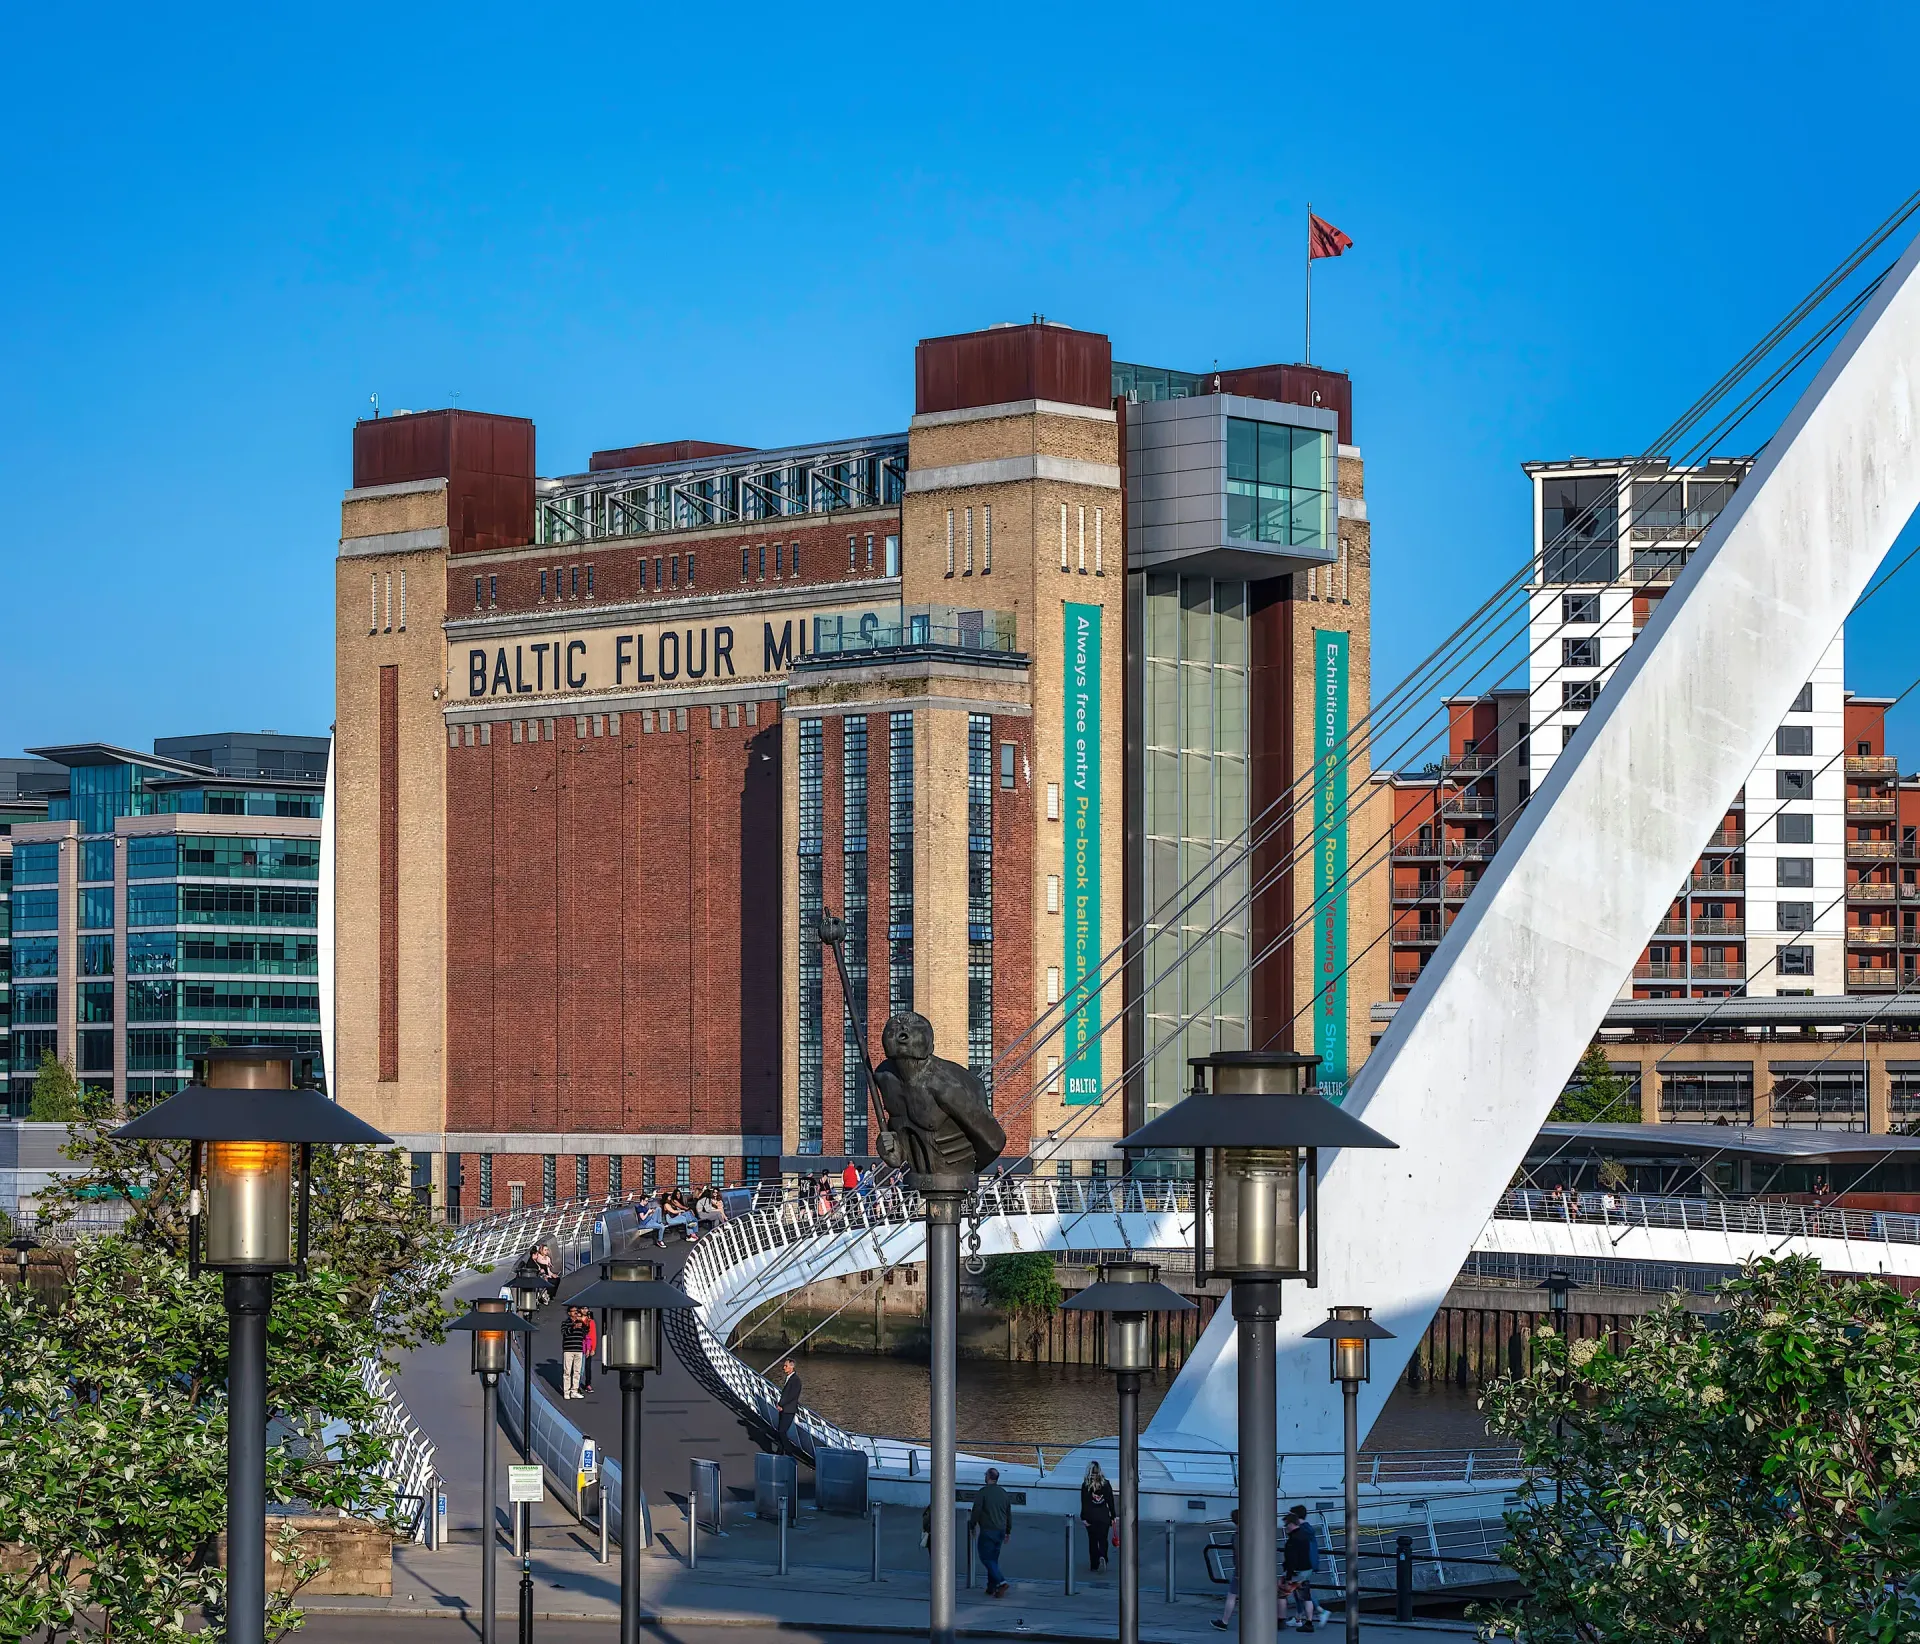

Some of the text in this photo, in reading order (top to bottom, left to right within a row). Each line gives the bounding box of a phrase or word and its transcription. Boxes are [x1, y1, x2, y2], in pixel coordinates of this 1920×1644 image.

[470, 640, 587, 697] BALTIC
[616, 626, 734, 685] FLOUR
[1074, 616, 1090, 687] Always
[1076, 693, 1089, 733] free
[1074, 739, 1089, 791] entry
[1076, 797, 1089, 889] Pre-book
[1323, 643, 1338, 1074] Exhibitions Sensory Room Viewing Box Shop
[1070, 1077, 1097, 1094] BALTIC
[1319, 1080, 1343, 1096] BALTIC
